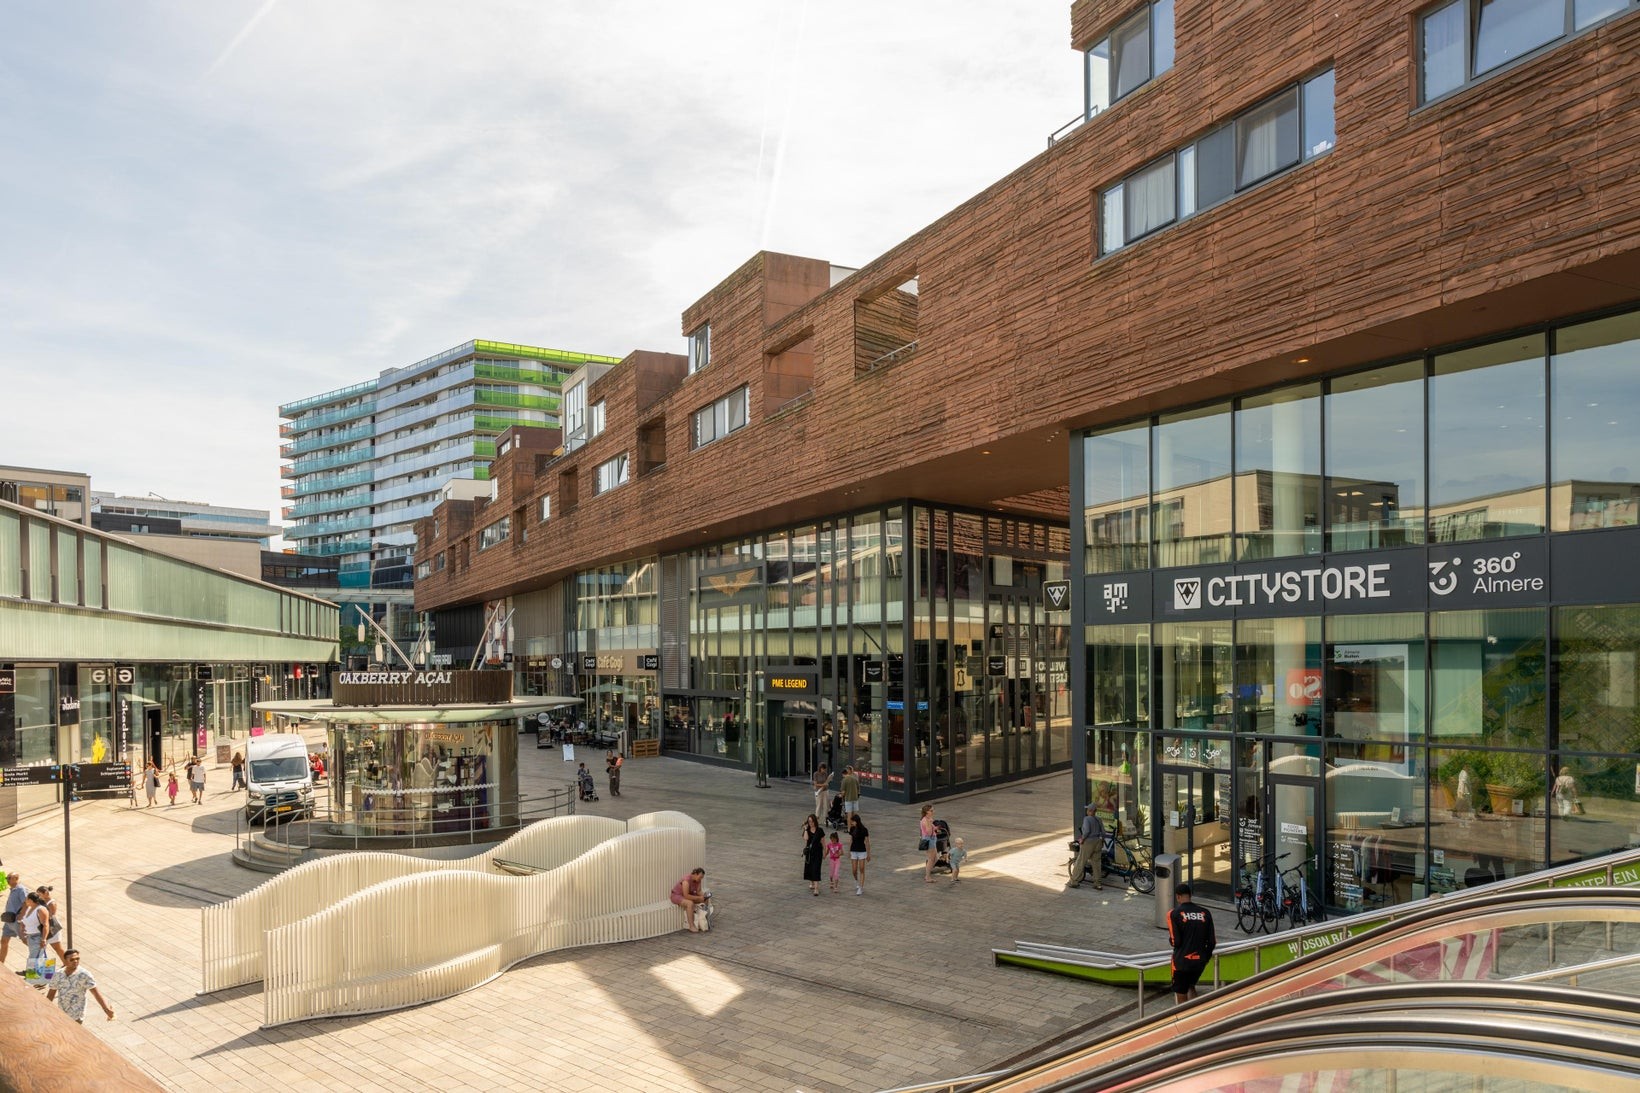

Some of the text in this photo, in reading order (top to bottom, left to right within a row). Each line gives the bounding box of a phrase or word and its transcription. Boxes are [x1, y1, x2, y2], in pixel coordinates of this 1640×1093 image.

[1473, 551, 1521, 575] 360°
[1207, 563, 1391, 606] CITYSTORE
[1472, 577, 1544, 594] Almere
[339, 672, 412, 684] OAKBERRY
[772, 679, 807, 689] PME LEGEND
[1183, 912, 1204, 921] HSB
